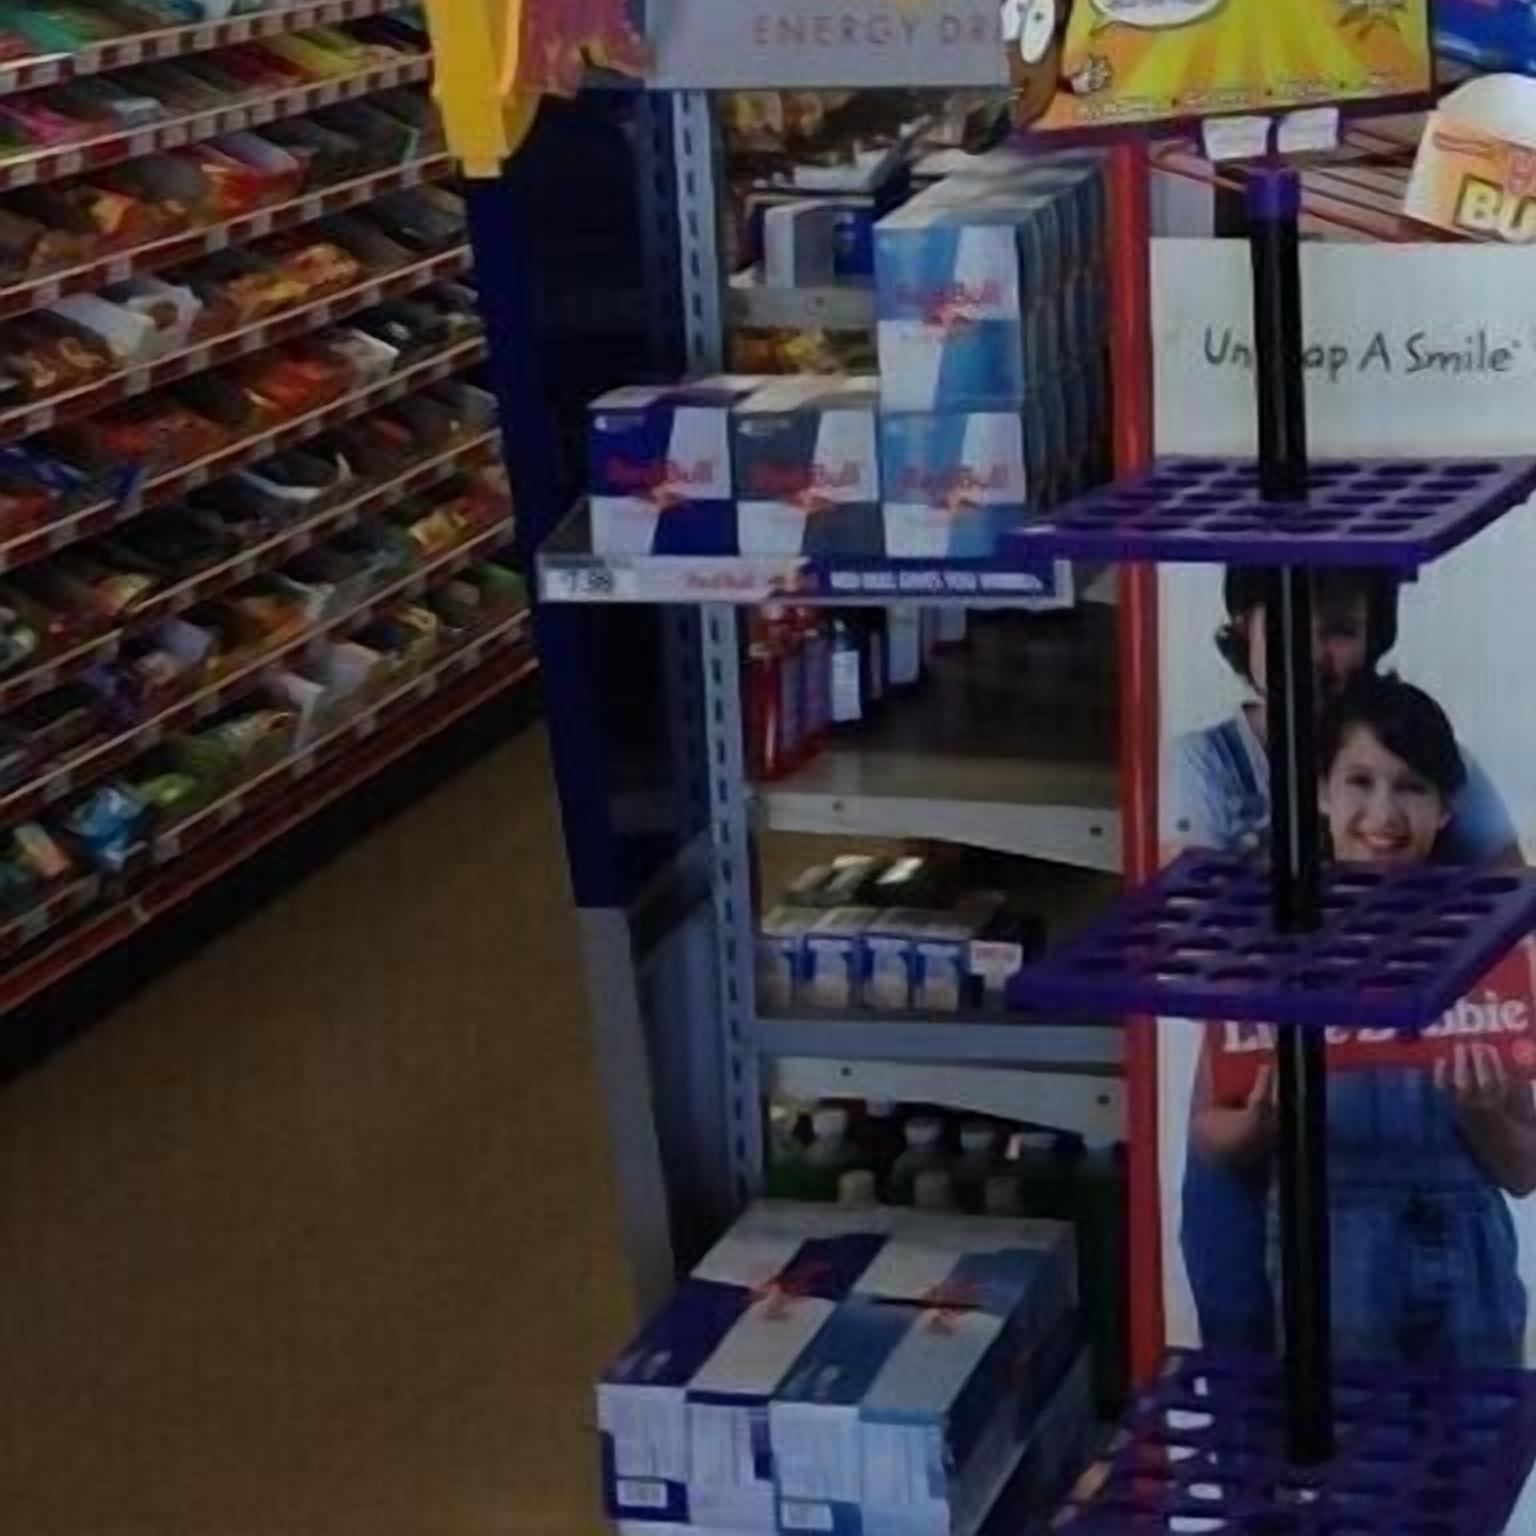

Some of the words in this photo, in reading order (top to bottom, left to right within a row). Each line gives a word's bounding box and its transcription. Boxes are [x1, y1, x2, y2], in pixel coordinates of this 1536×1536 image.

[753, 15, 919, 45] ENERGY
[1204, 327, 1349, 383] Unap
[1357, 331, 1392, 373] A
[1405, 330, 1514, 375] Smile
